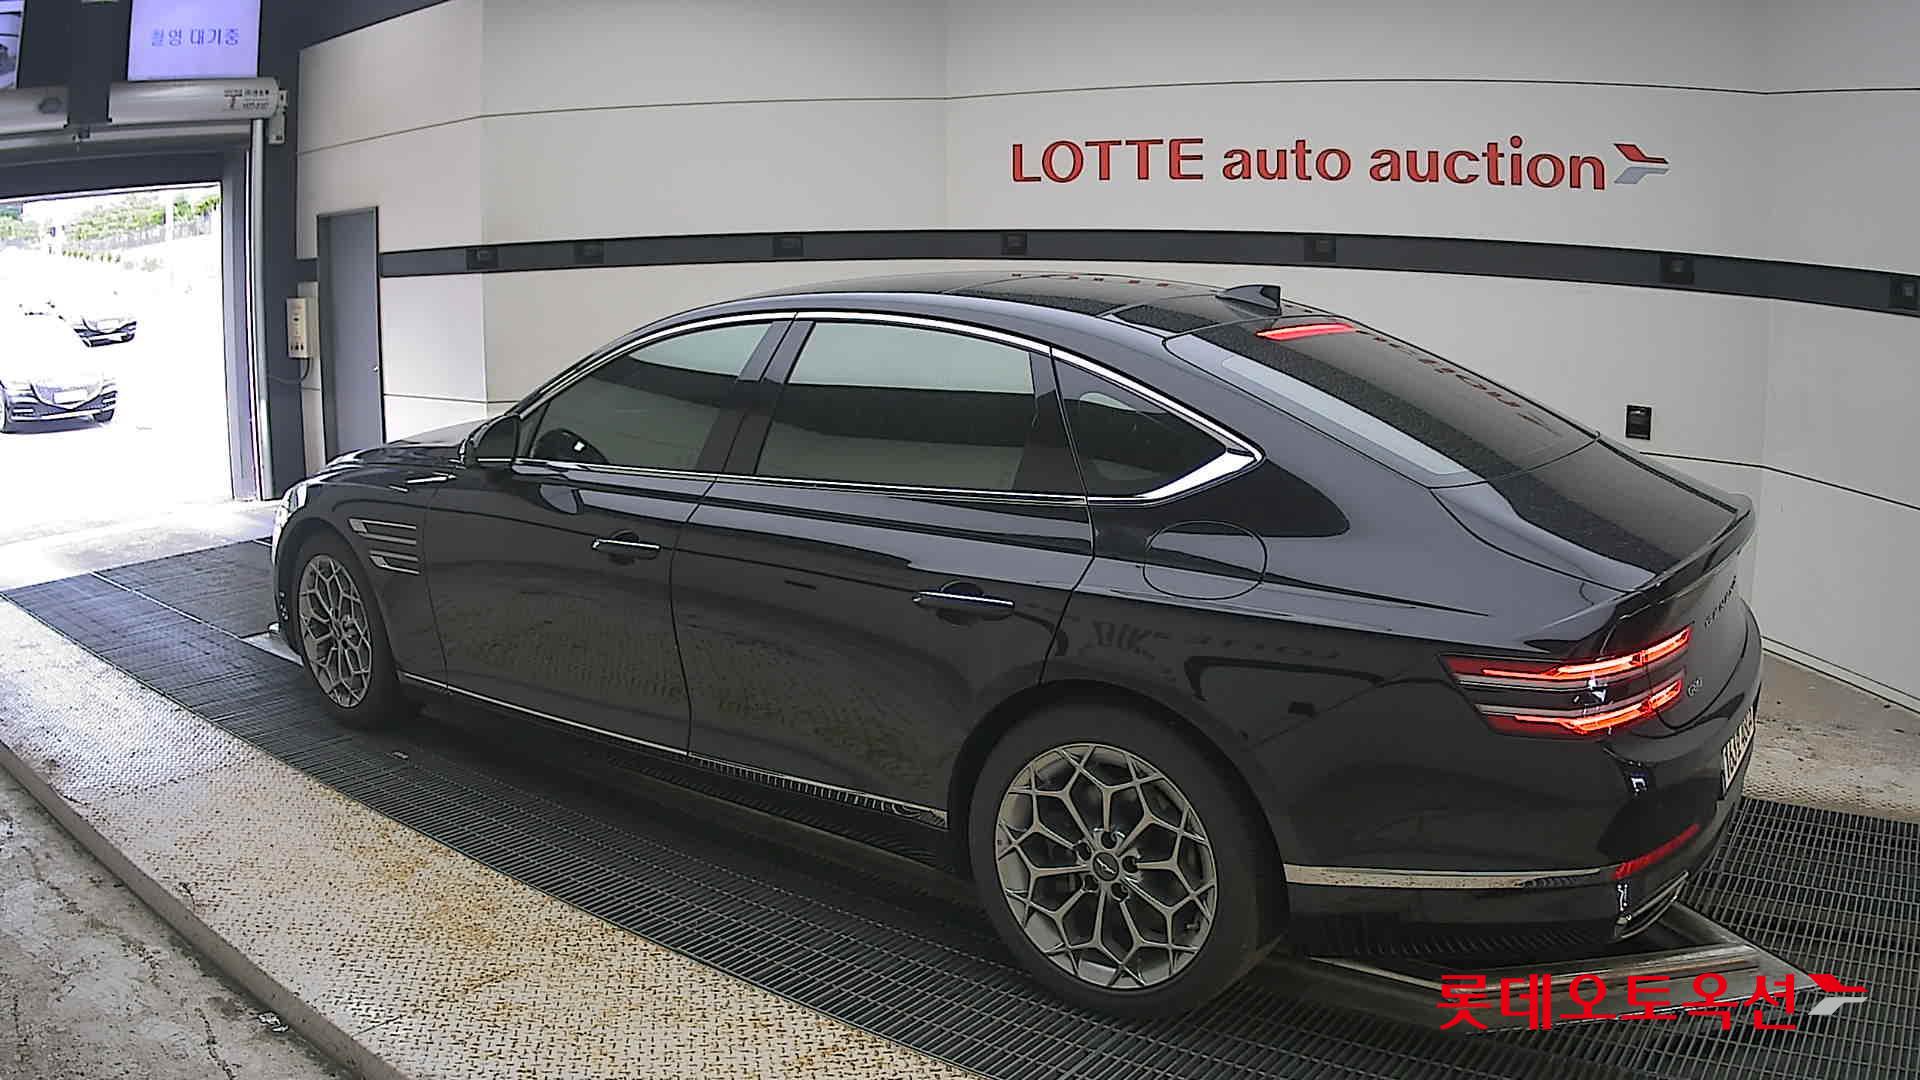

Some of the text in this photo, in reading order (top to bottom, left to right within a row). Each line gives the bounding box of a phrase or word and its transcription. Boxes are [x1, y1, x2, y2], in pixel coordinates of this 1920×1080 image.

[190, 28, 239, 46] 대기중
[1011, 135, 1606, 191] LOTTE auto auction
